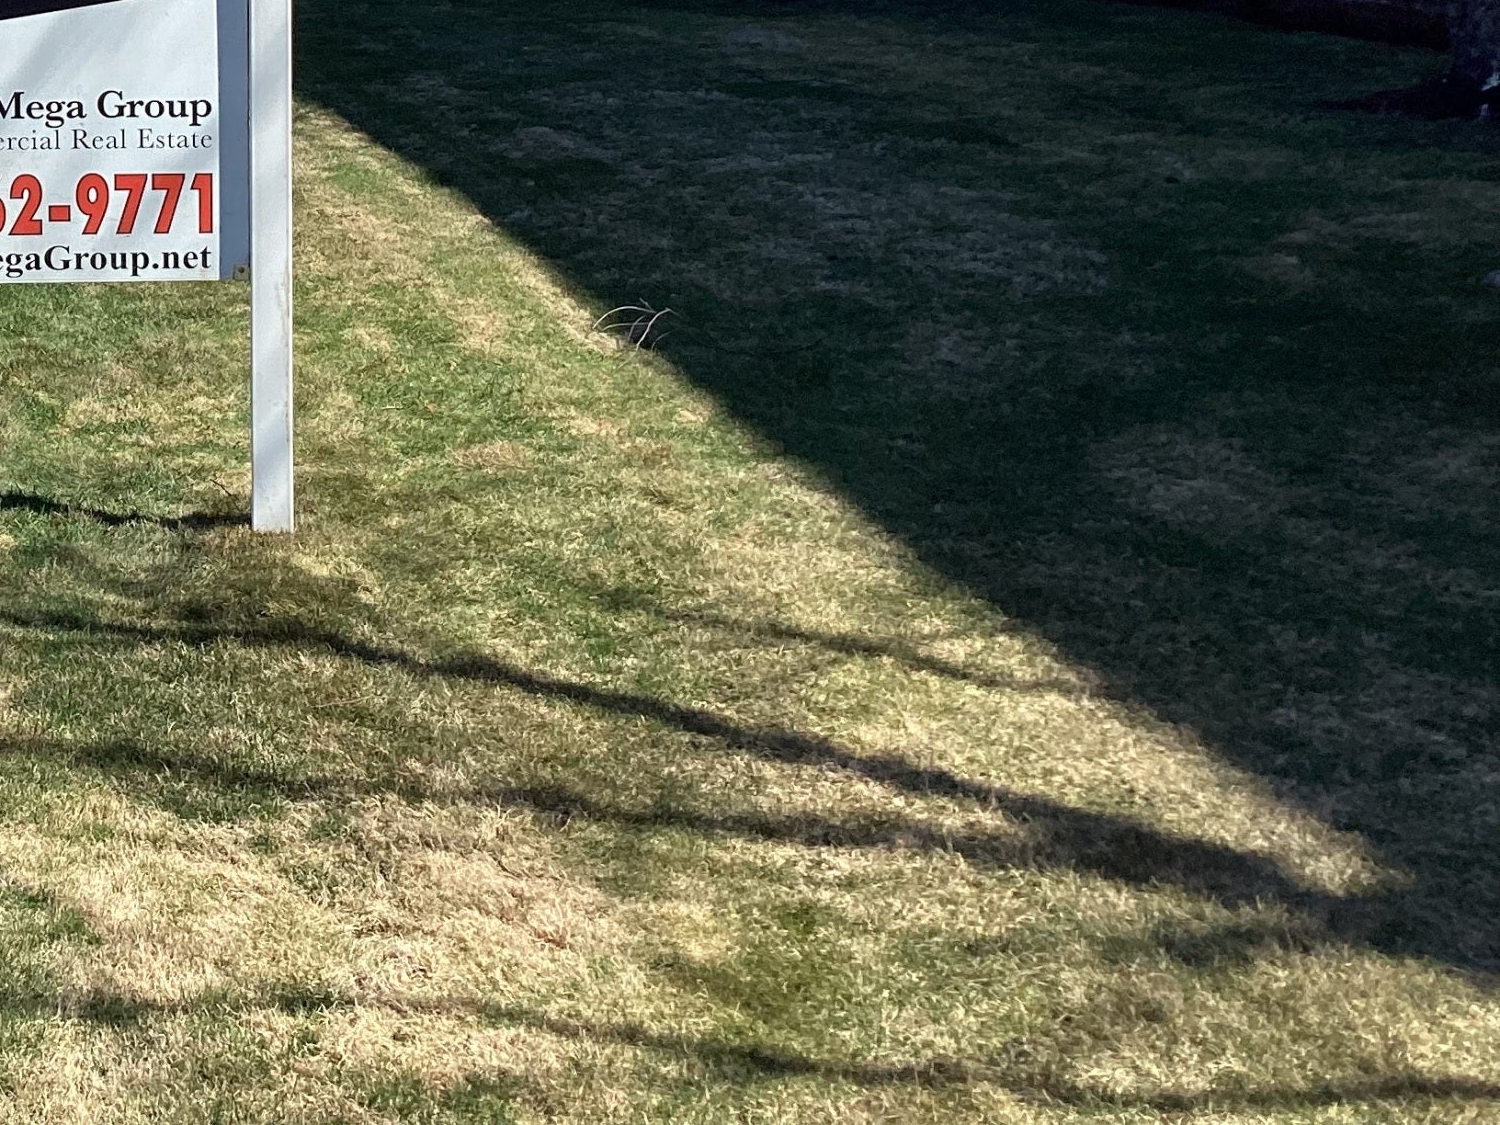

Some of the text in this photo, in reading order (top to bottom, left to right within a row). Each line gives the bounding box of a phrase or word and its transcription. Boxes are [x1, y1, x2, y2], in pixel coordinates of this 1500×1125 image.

[97, 90, 212, 127] Group
[71, 128, 127, 150] Real
[137, 128, 213, 149] Estate
